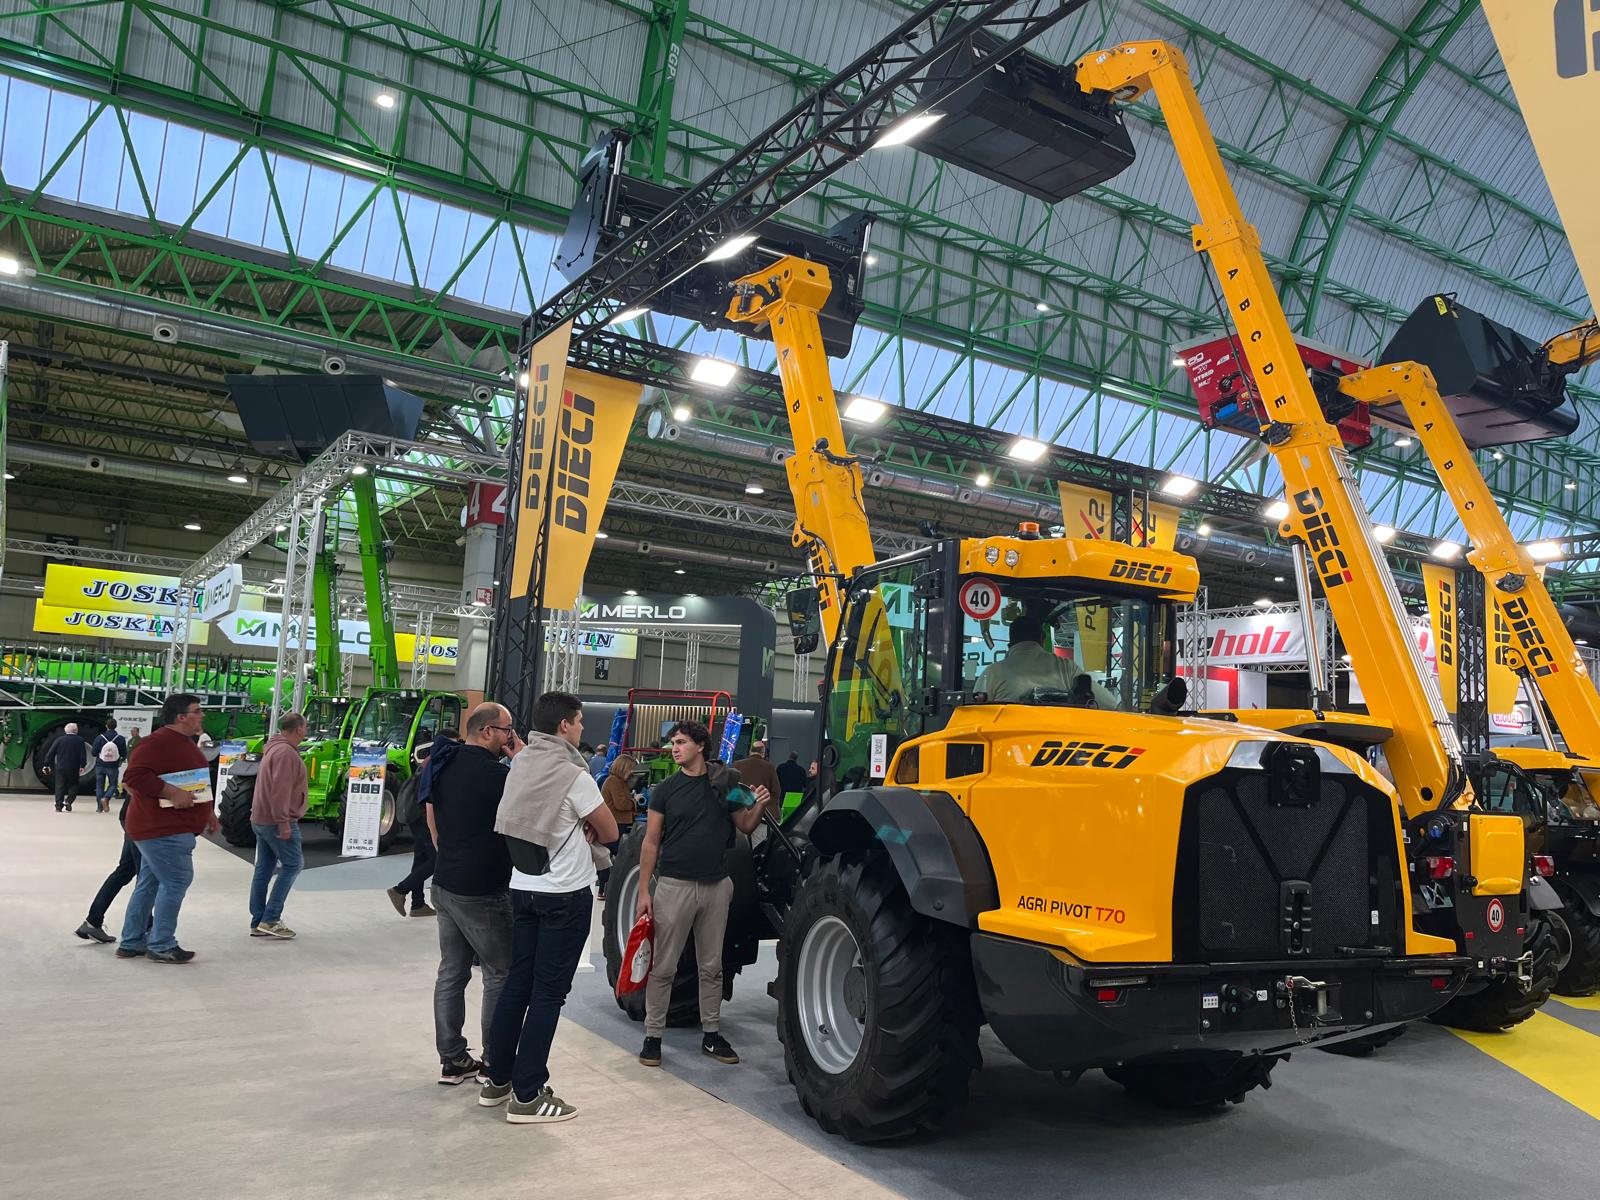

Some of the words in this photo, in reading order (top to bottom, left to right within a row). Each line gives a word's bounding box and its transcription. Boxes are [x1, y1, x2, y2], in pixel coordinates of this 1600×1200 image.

[1227, 268, 1238, 280] A
[1239, 297, 1250, 311] B
[1251, 330, 1261, 342] C
[1263, 362, 1274, 375] D
[1274, 395, 1286, 408] E
[525, 364, 549, 509] DIECI
[554, 389, 595, 534] DIECI
[1424, 422, 1433, 431] A
[1443, 460, 1453, 470] B
[1464, 501, 1474, 511] C
[1293, 486, 1353, 589] DIECI
[1109, 559, 1173, 584] DIECI
[83, 580, 204, 608] JOSKI
[970, 590, 990, 608] 40
[603, 605, 687, 619] MERLO
[1438, 579, 1452, 666] DIECI
[272, 622, 371, 645] MELO
[1502, 597, 1559, 677] DIECI
[1030, 740, 1146, 769] DIECI
[1017, 895, 1047, 912] AGRI
[1050, 900, 1092, 919] PIVOT
[1096, 906, 1126, 924] T70
[1491, 909, 1500, 922] 40
